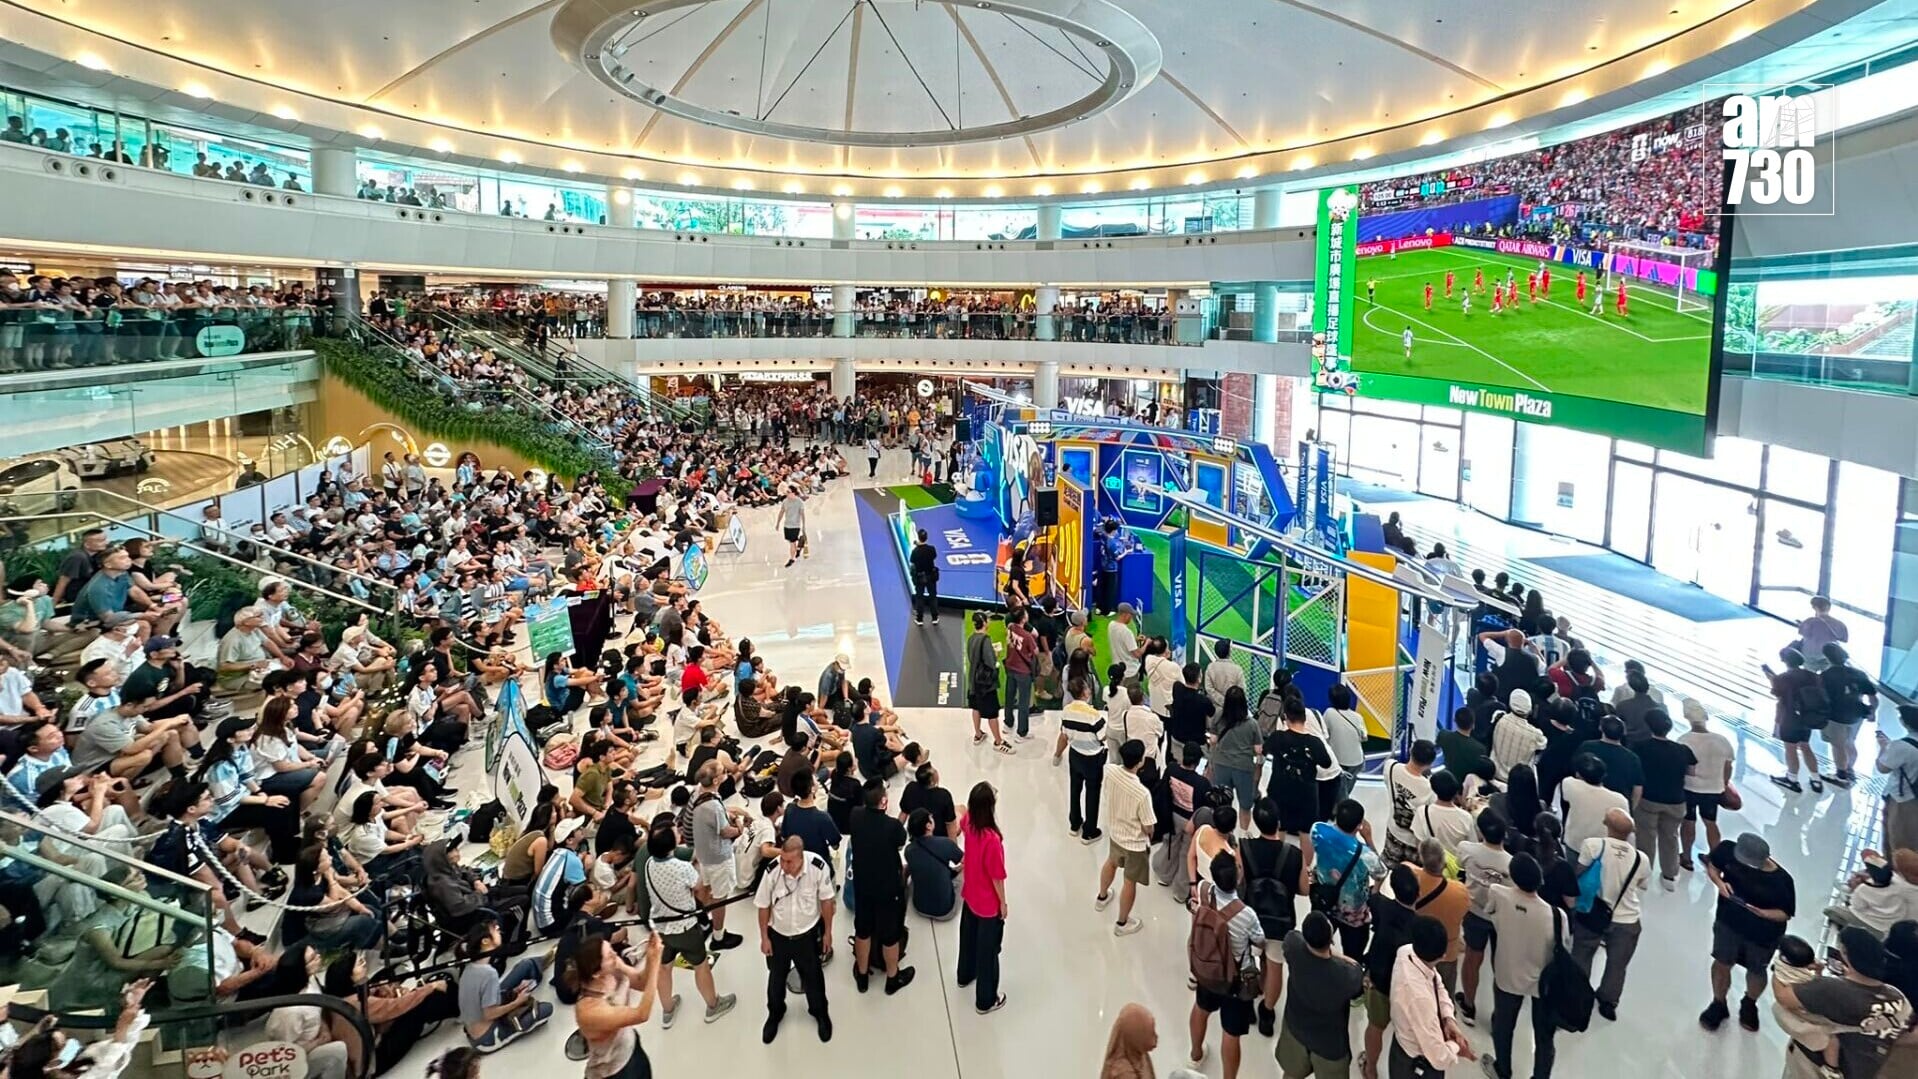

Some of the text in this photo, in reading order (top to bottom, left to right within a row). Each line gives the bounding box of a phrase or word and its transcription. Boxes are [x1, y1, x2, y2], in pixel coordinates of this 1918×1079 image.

[1356, 243, 1384, 255] enovo
[1398, 238, 1433, 249] Lenovo
[1499, 240, 1551, 258] QATAR AIRWAYS
[1572, 248, 1593, 266] VISA
[1064, 396, 1105, 417] VISA
[1449, 385, 1552, 418] New Town Plaza
[1000, 425, 1029, 479] VISA
[943, 527, 973, 549] VISA
[1173, 571, 1182, 609] VISA
[239, 1046, 297, 1068] pet's
